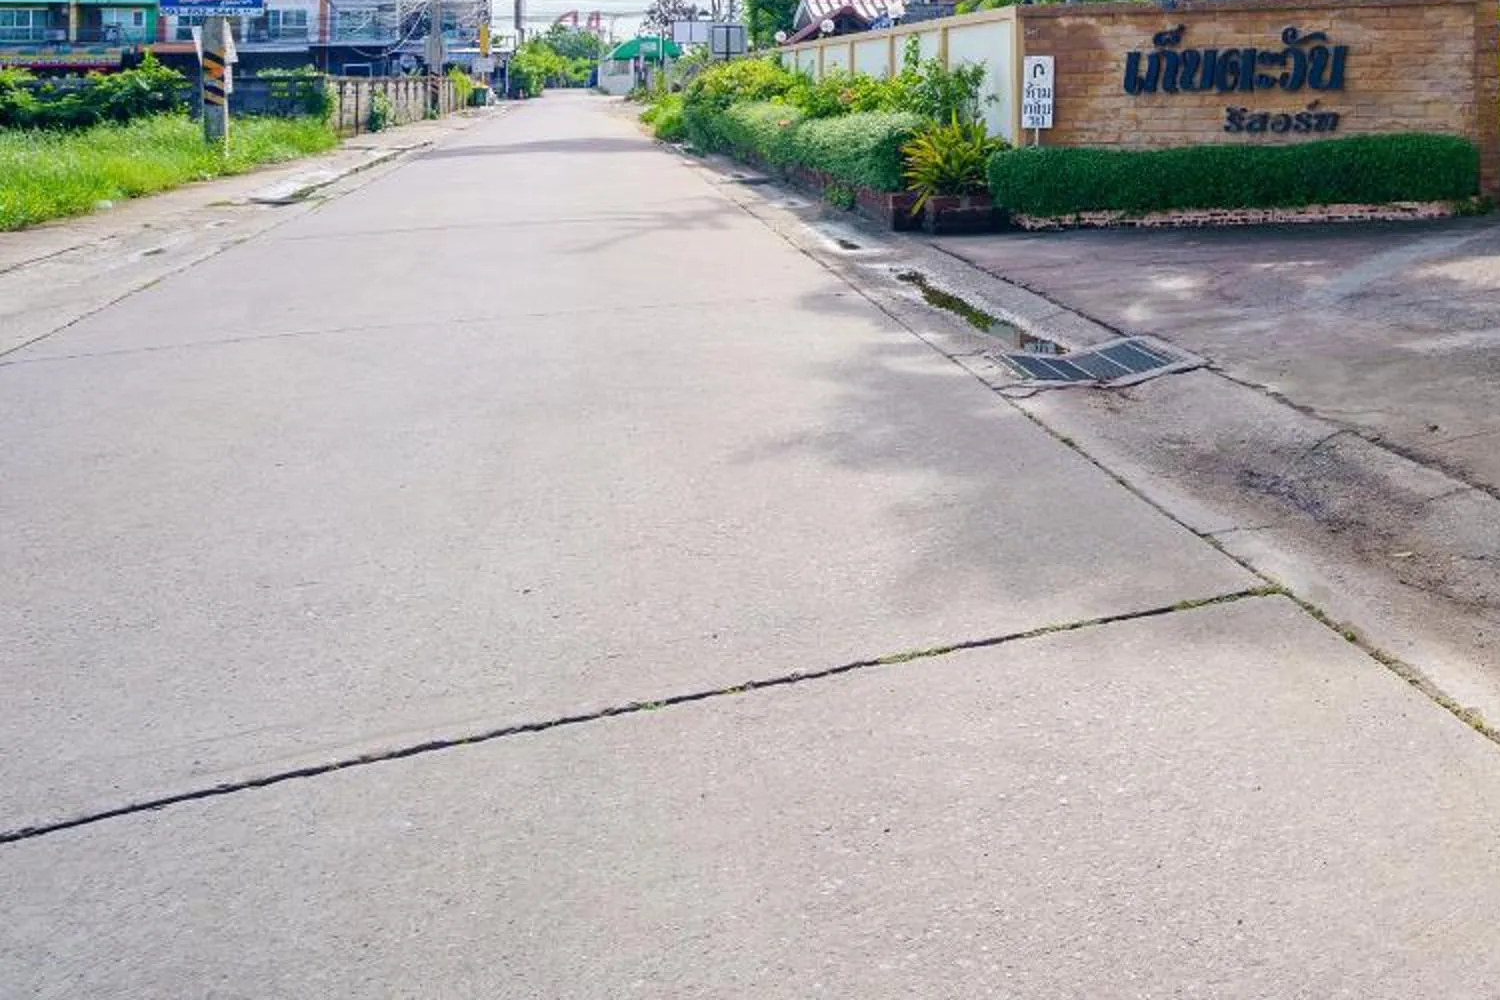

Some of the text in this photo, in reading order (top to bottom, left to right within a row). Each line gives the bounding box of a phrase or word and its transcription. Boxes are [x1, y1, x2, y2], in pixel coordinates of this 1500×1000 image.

[1123, 23, 1349, 96] เก็บตะวัน
[1223, 99, 1341, 133] รีสอร์ท
